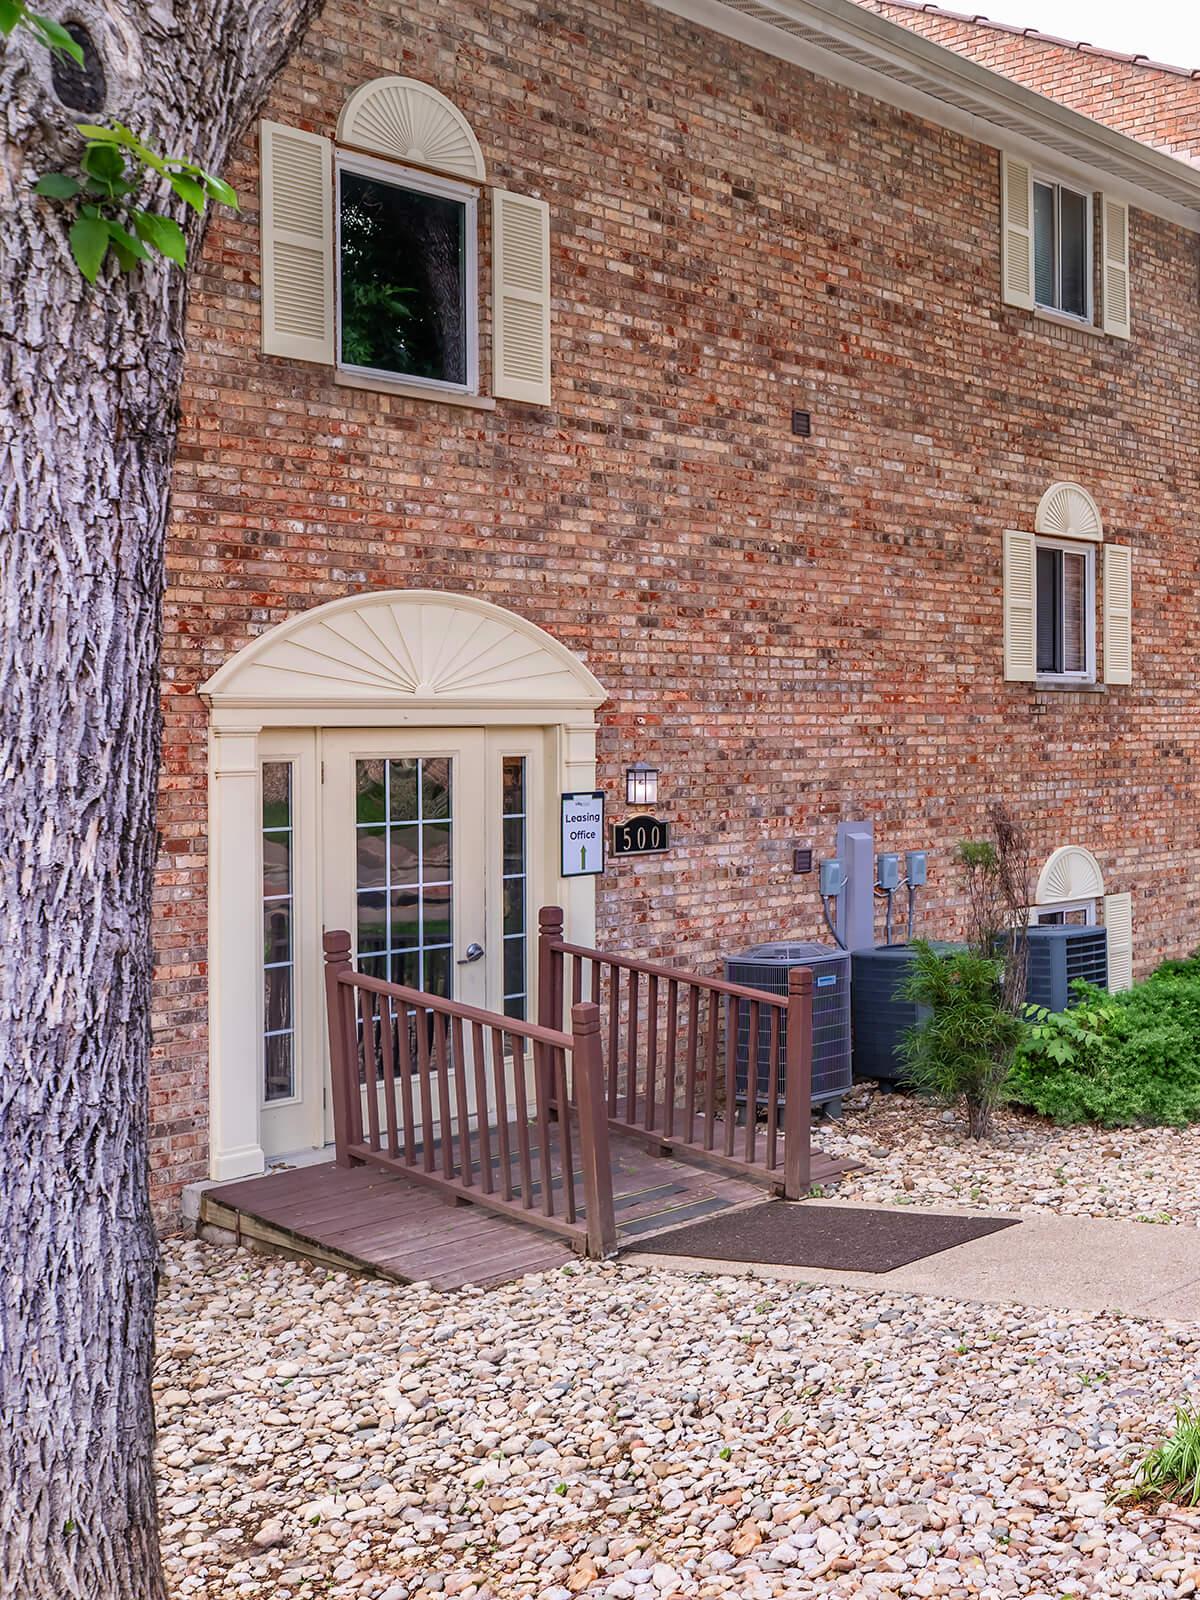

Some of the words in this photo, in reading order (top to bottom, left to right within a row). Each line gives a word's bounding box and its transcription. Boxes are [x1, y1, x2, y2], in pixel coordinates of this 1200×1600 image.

[565, 812, 600, 823] Leasing
[570, 830, 596, 841] Office
[623, 826, 660, 850] 500
